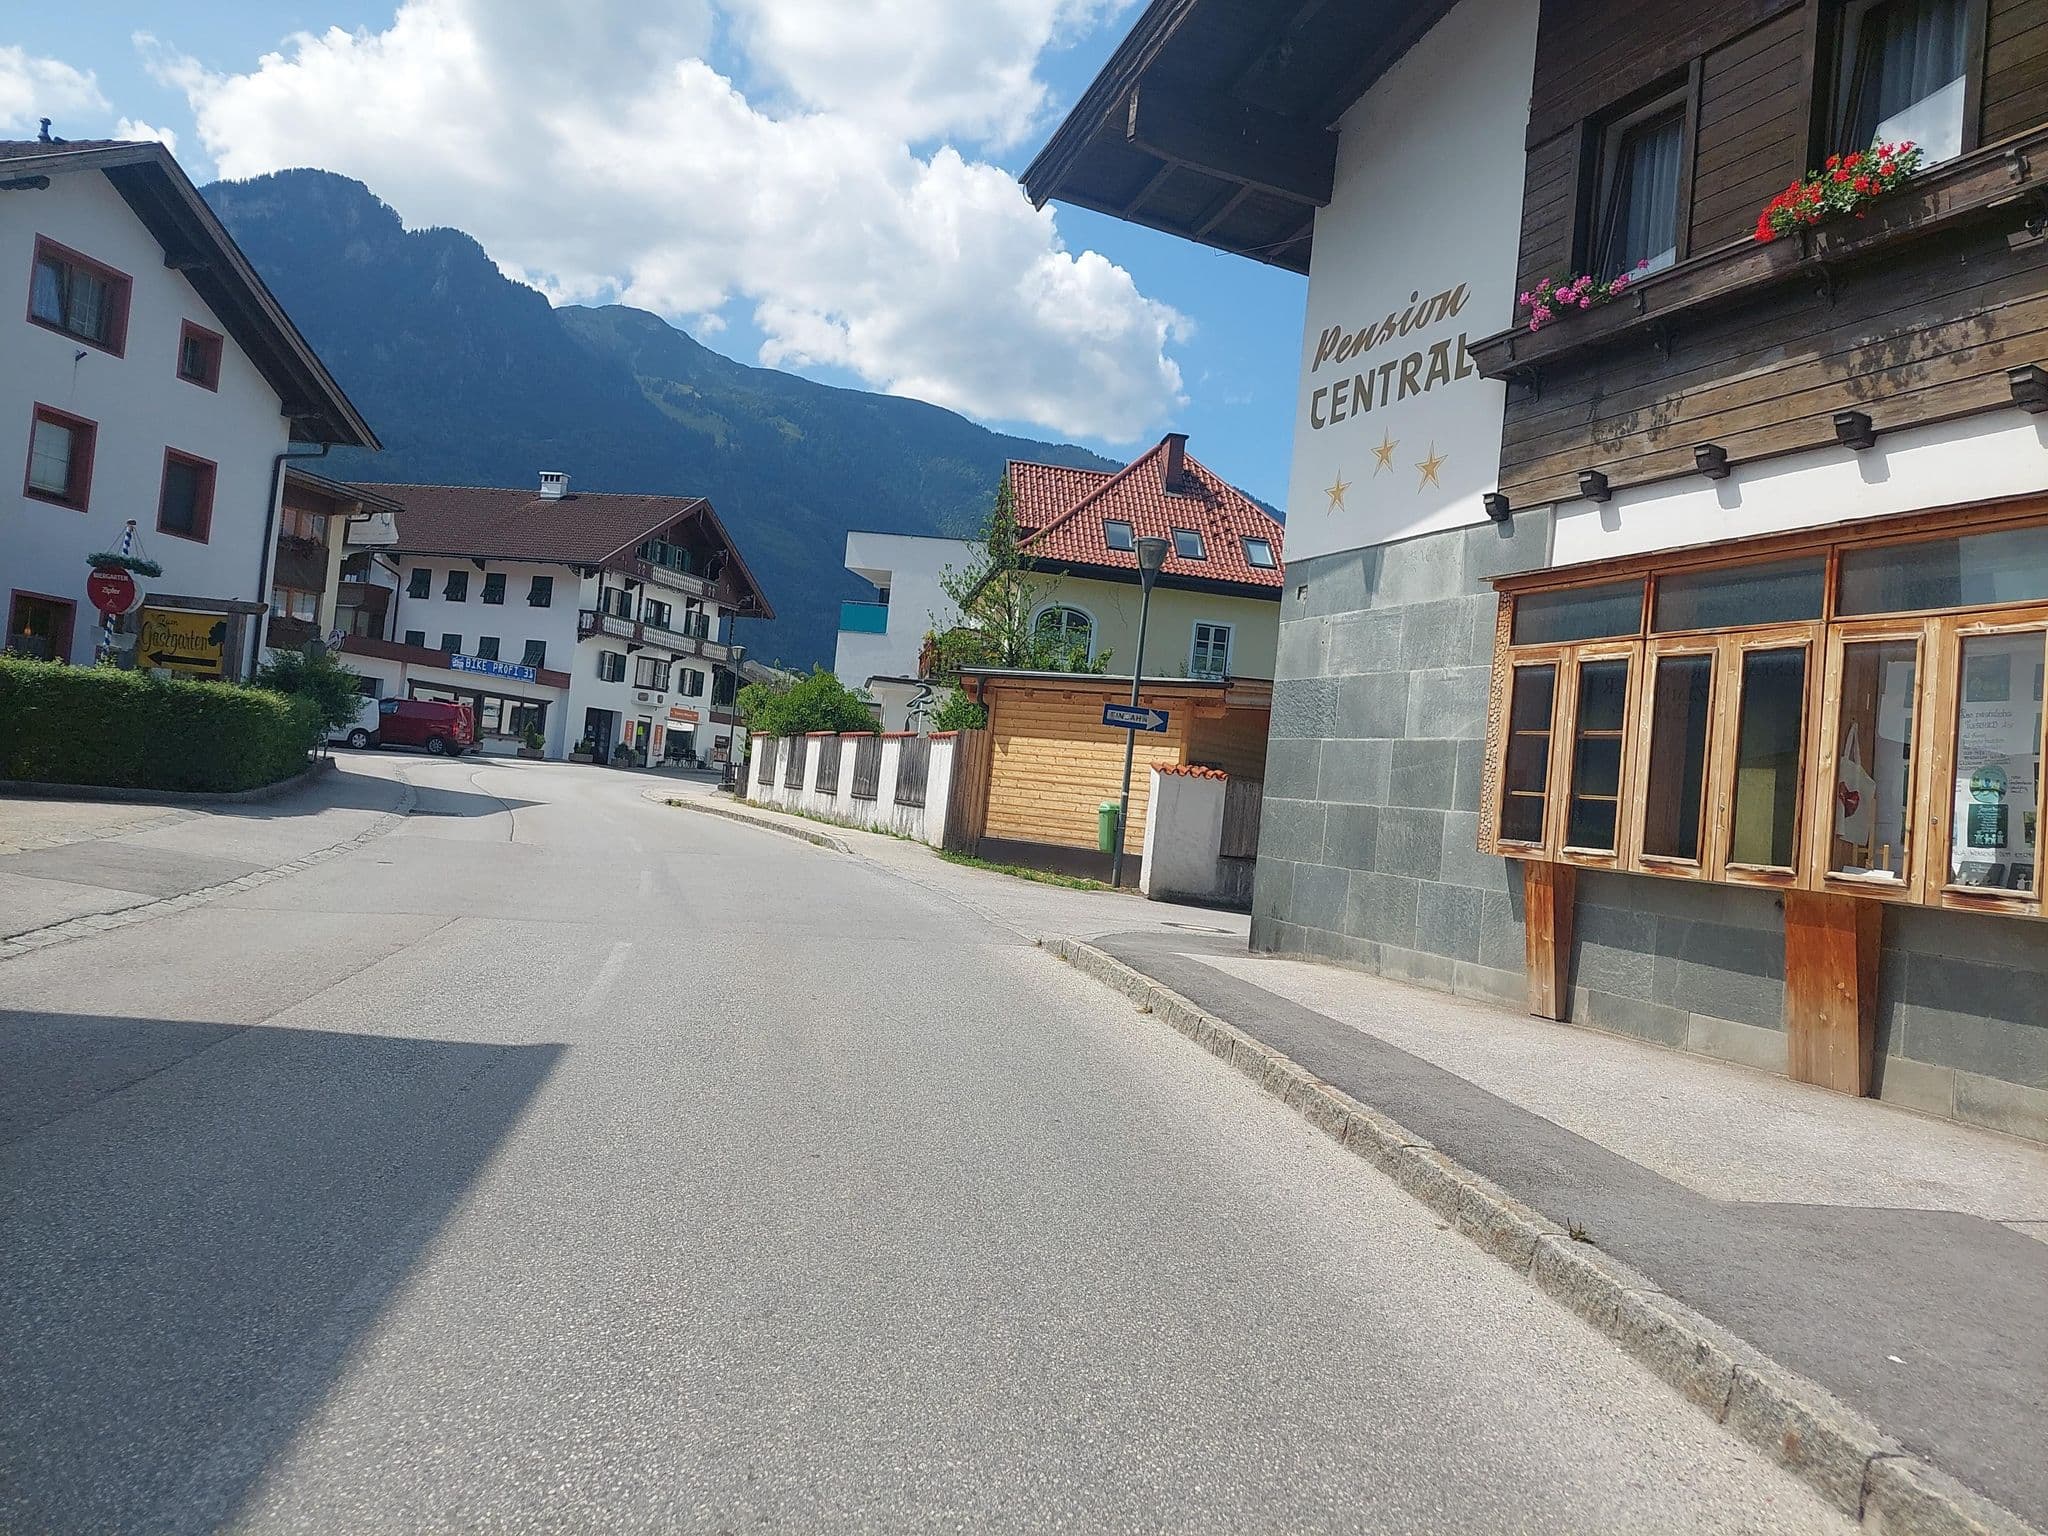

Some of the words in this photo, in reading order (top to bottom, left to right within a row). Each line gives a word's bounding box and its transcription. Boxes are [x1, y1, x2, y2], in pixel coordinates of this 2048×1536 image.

[1311, 282, 1471, 373] Pension
[1310, 332, 1473, 430] CENTRAL
[141, 620, 208, 654] Gastgarten
[465, 657, 487, 671] BIKE
[492, 662, 518, 676] PROFI
